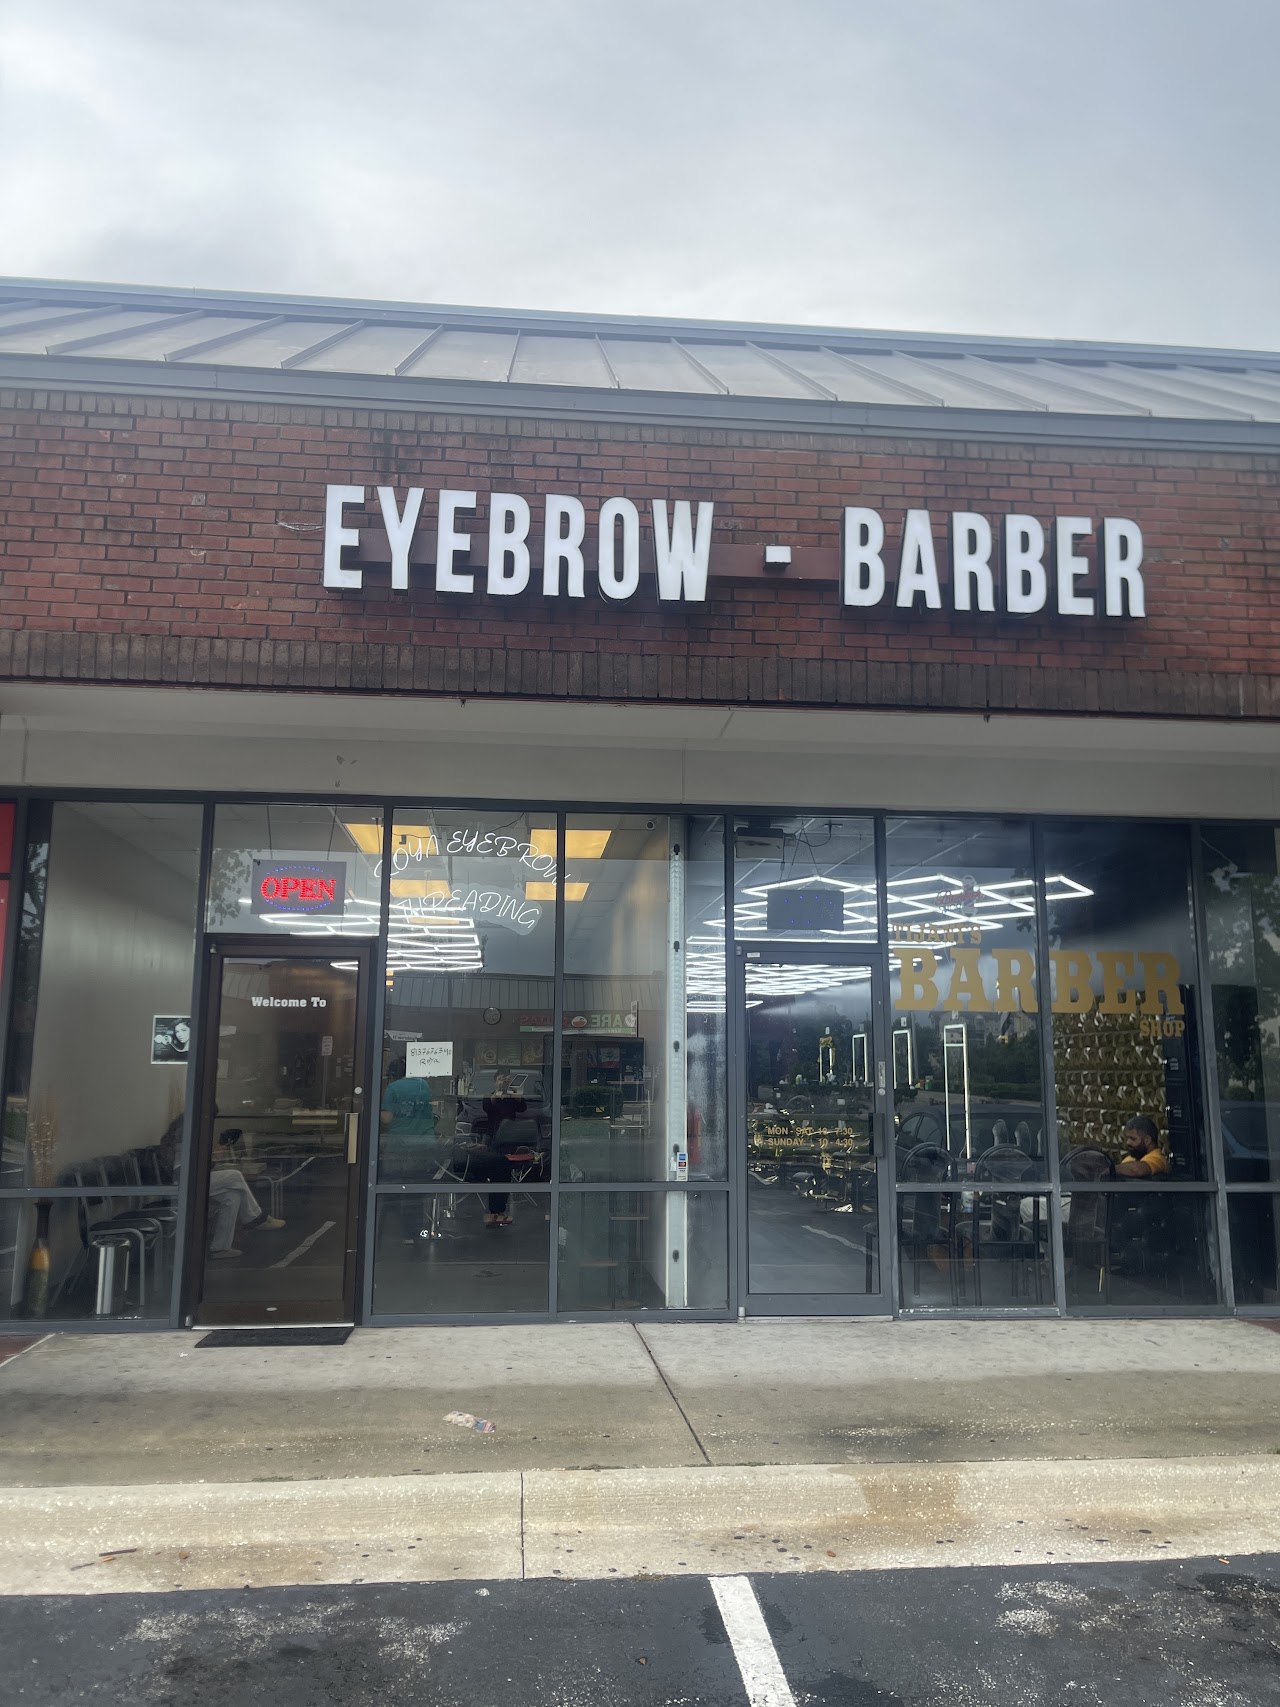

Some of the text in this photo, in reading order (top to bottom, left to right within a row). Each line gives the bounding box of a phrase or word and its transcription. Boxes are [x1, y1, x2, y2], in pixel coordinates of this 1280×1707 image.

[323, 484, 714, 602] EYEBROW
[843, 506, 1146, 618] BARBER
[260, 876, 337, 900] OPEN
[893, 947, 1185, 1015] BARBER
[251, 996, 327, 1008] Welcome To
[1139, 1018, 1185, 1037] SHOP
[768, 1127, 788, 1135] MON
